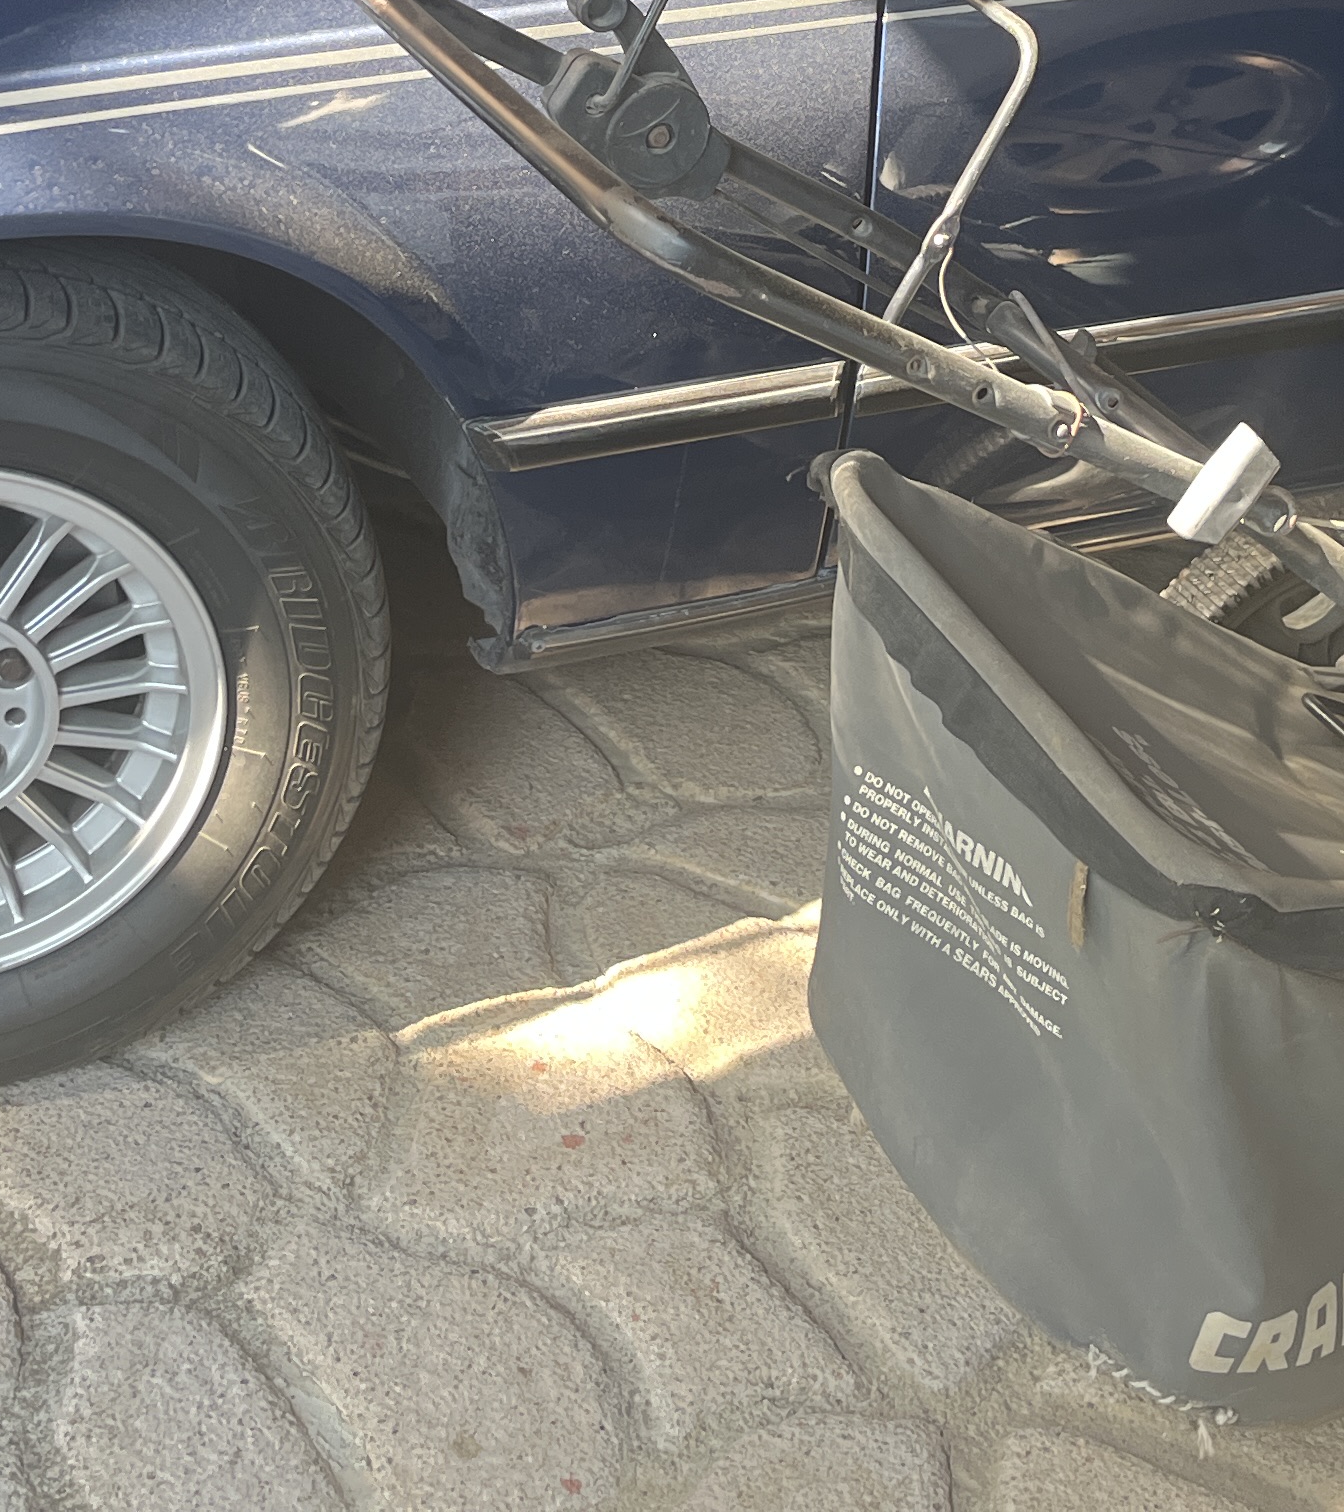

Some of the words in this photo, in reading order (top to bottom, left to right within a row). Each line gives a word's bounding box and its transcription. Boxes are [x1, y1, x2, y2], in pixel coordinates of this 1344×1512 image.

[858, 783, 922, 828] PROPERLY
[845, 830, 858, 848] TO
[858, 841, 893, 871] WEAR
[892, 865, 921, 888] AND
[852, 801, 870, 819] DO
[870, 812, 898, 835] NOT
[897, 829, 946, 868] REMOVE
[1010, 941, 1022, 957] IS
[864, 771, 884, 788] DO
[884, 782, 911, 805] NOT
[969, 876, 1009, 913] UNLESS
[1010, 905, 1034, 931] BAG
[943, 820, 1033, 909] ARNIN
[847, 818, 891, 854] DURING
[894, 849, 944, 888] NORMAL
[947, 884, 967, 908] USE
[1016, 965, 1069, 1006] SUBJECT
[875, 876, 902, 901] BAG
[905, 894, 980, 952] FREQUENTLY
[876, 899, 911, 926] ONLY
[910, 920, 942, 949] WITH
[942, 942, 952, 957] A
[953, 947, 998, 988] SEARS
